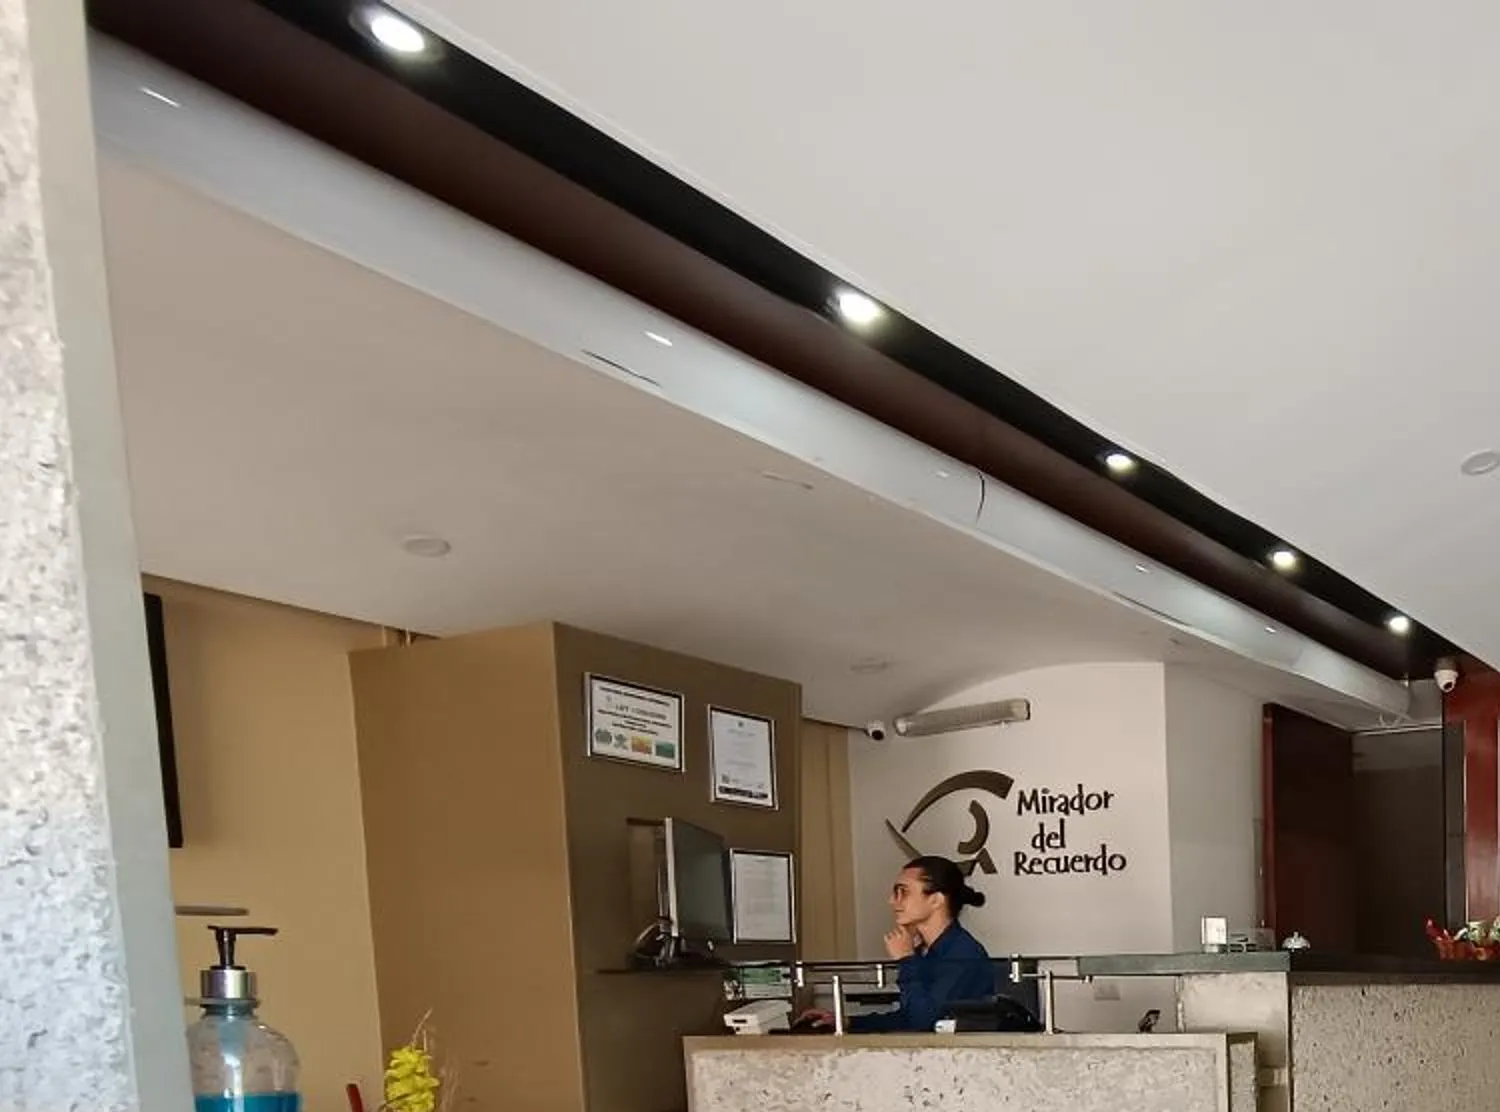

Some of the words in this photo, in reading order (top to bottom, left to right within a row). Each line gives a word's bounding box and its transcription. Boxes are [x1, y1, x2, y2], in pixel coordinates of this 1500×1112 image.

[1016, 783, 1115, 816] Mirador
[1031, 817, 1066, 854] del
[1013, 843, 1127, 876] Recuerdo
